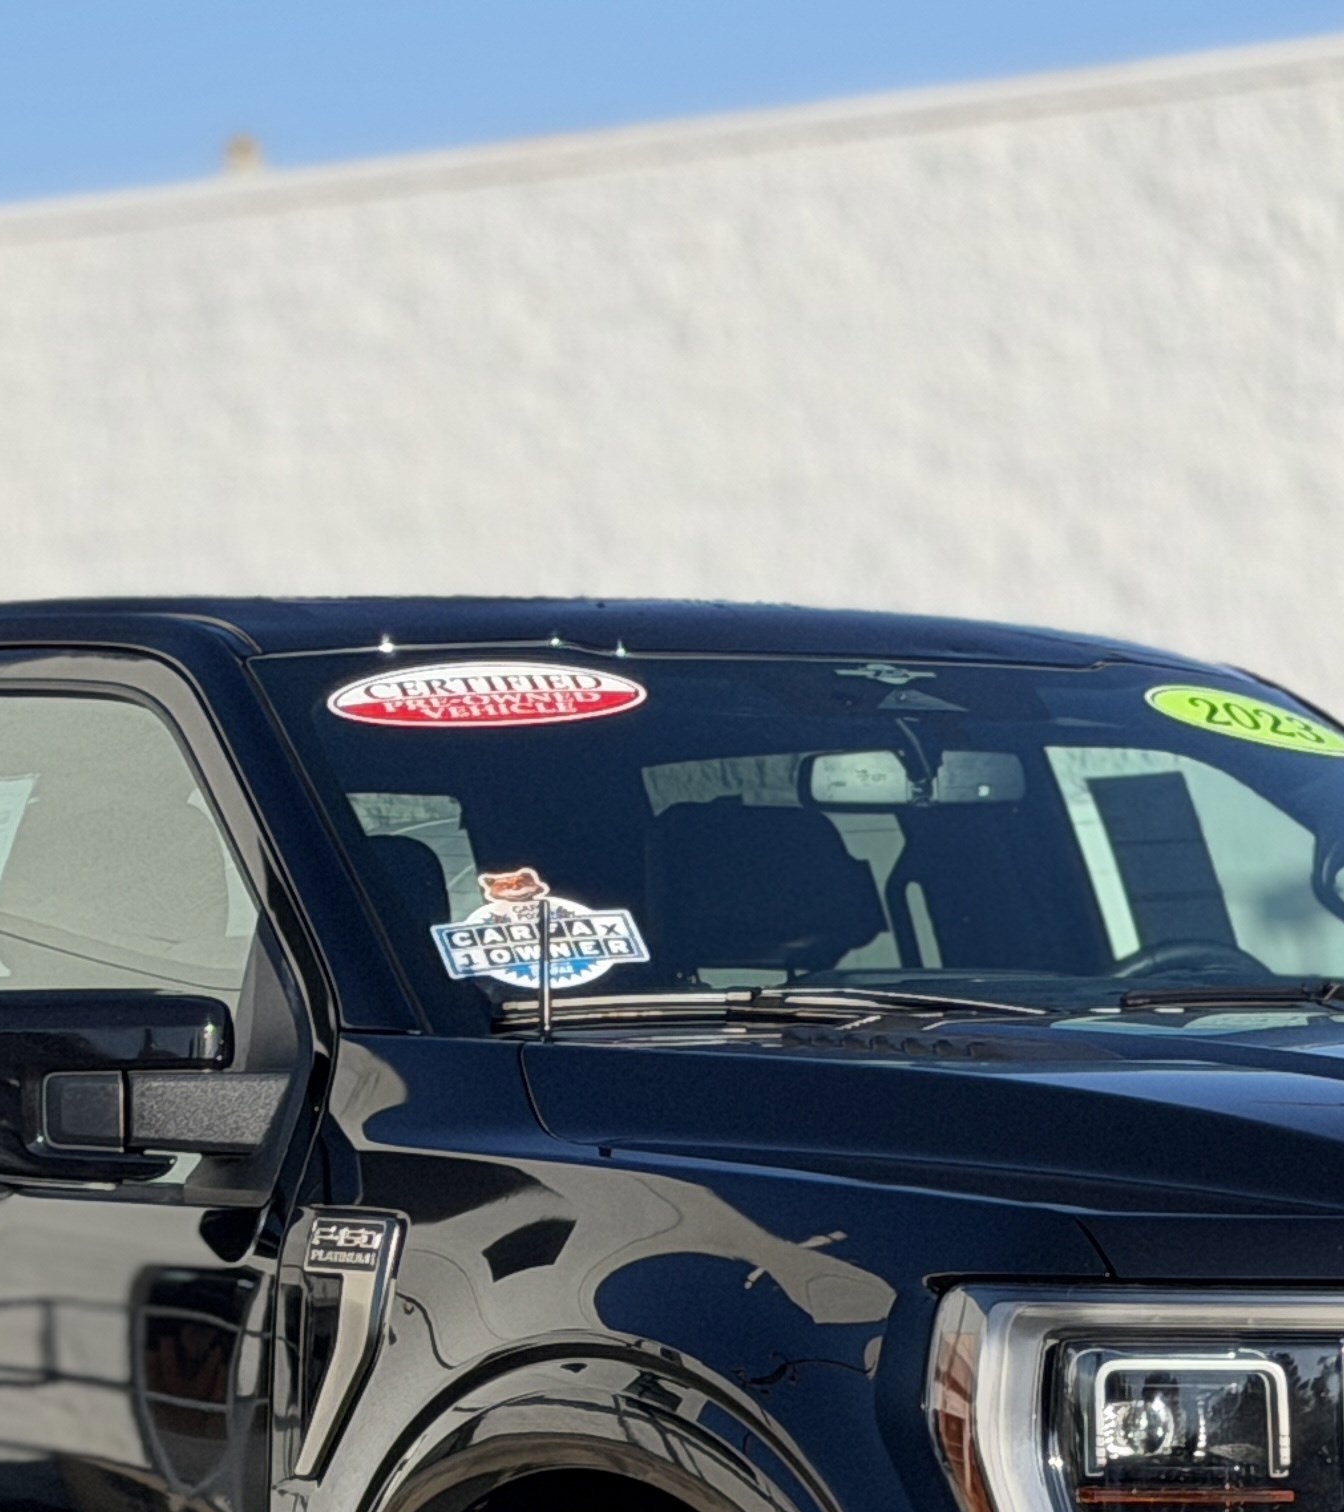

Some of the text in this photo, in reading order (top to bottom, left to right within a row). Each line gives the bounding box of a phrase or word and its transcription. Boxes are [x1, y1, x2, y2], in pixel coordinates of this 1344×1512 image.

[363, 674, 603, 700] CERTIFIED
[383, 690, 602, 713] PRE-OWNED
[421, 701, 577, 719] VEHICLE
[1188, 697, 1325, 744] 2023
[310, 1249, 376, 1266] PLATINUM
